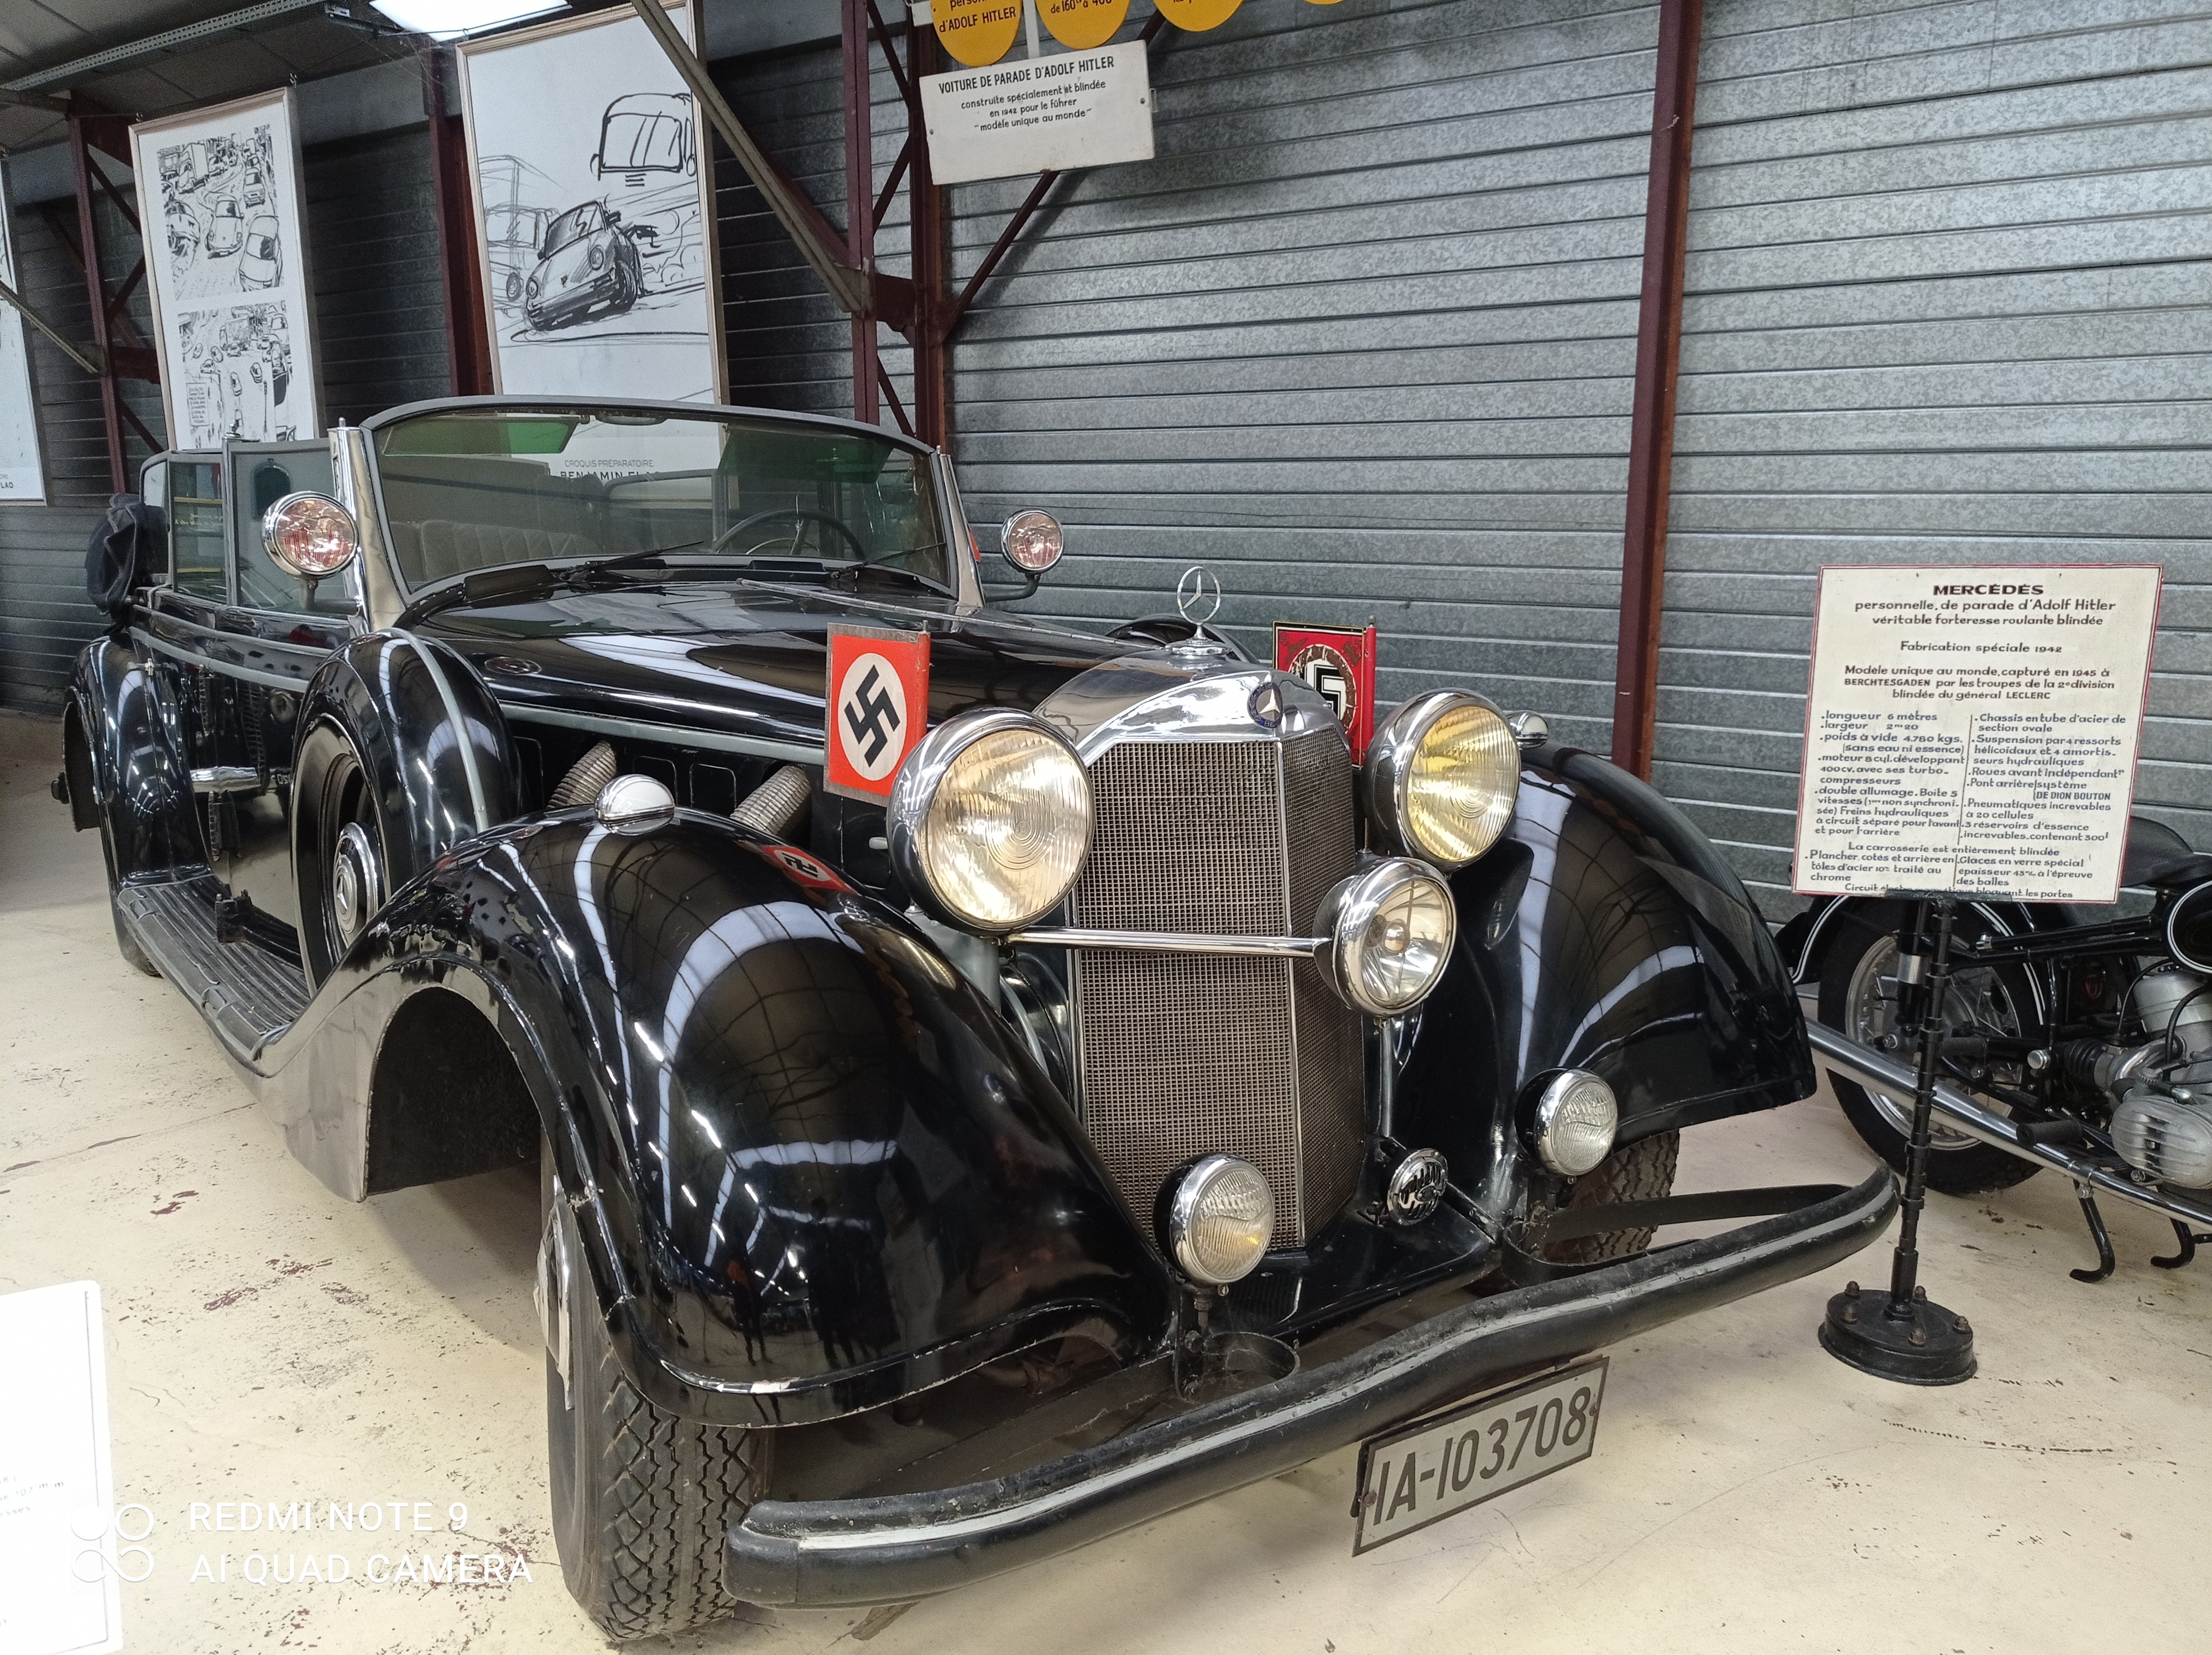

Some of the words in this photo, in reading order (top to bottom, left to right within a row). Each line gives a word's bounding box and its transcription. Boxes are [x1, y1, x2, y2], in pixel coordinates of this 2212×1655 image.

[1051, 4, 1060, 13] de
[939, 14, 978, 32] d'ADOLF
[982, 7, 1016, 23] HITLER
[939, 77, 978, 94] VOITURE
[980, 75, 992, 88] DE
[995, 69, 1031, 85] PARADE
[1035, 63, 1074, 79] D'ADOLF
[1078, 56, 1114, 73] HITLER
[961, 95, 1004, 110] construite
[1007, 87, 1062, 103] spécialement
[1064, 86, 1073, 94] et
[1074, 80, 1106, 92] blindée
[1020, 105, 1039, 115] pour
[1041, 101, 1048, 110] le
[1011, 116, 1039, 126] unique
[1933, 584, 2044, 596] MERCÉDÉS
[1855, 600, 1938, 612] personnelle,
[1940, 600, 1958, 610] de
[1963, 599, 2014, 612] parade
[2018, 598, 2071, 610] d'Adolf
[2075, 599, 2116, 610] Hitler
[1872, 614, 1932, 624] véritable
[1936, 613, 2000, 624] forteresse
[2003, 614, 2054, 624] roulante
[2057, 614, 2103, 625] blindée
[1901, 641, 1970, 651] Fabrication
[1976, 642, 2030, 653] spéciale
[1845, 665, 1888, 674] Modèle
[1891, 667, 1933, 676] unique
[2002, 667, 2050, 678] capturé
[1959, 678, 1974, 687] les
[1977, 678, 2021, 689] troupes
[2025, 679, 2040, 688] de
[2044, 679, 2054, 688] la
[2071, 680, 2115, 689] division
[1892, 689, 1934, 698] blindée
[1938, 690, 1953, 699] du
[1955, 691, 2001, 701] général
[1897, 711, 1938, 720] mètres
[2040, 713, 2066, 722] tube
[2069, 714, 2109, 723] d'acier
[2112, 715, 2126, 724] de
[1979, 723, 2018, 732] section
[2022, 724, 2052, 732] ovale
[1871, 733, 1897, 741] vide
[2074, 736, 2121, 745] ressorts
[1915, 745, 1964, 756] essence)
[1974, 745, 2037, 754] hélicoïdaux
[1893, 754, 1965, 765] développant
[2007, 757, 2084, 767] hydrauliques
[1820, 777, 1901, 785] compresseurs
[2037, 780, 2086, 790] système
[1919, 788, 1948, 797] Boite
[2049, 802, 2111, 810] increvables
[1817, 807, 1837, 815] sée)
[1840, 806, 1871, 815] Freins
[1875, 807, 1948, 818] hydrauliques
[1992, 811, 2034, 819] cellules
[2033, 821, 2089, 830] d'essence
[1857, 826, 1900, 836] l'arrière
[1848, 842, 1863, 850] La
[1866, 844, 1928, 852] carrosserie
[1952, 846, 2016, 855] entièrement
[2020, 847, 2059, 856] blindée
[1861, 853, 1888, 861] cotés
[1903, 855, 1940, 863] arrière
[2044, 859, 2083, 867] spécial
[1812, 861, 1835, 870] tôles
[1838, 863, 1873, 872] d'acier
[1894, 865, 1923, 873] traité
[1811, 872, 1851, 881] chrome
[1959, 867, 2011, 876] épaisseur
[2047, 870, 2093, 878] l'épreuve
[1978, 877, 2009, 886] balles
[1845, 883, 1877, 891] Circuit
[2041, 889, 2073, 898] portes
